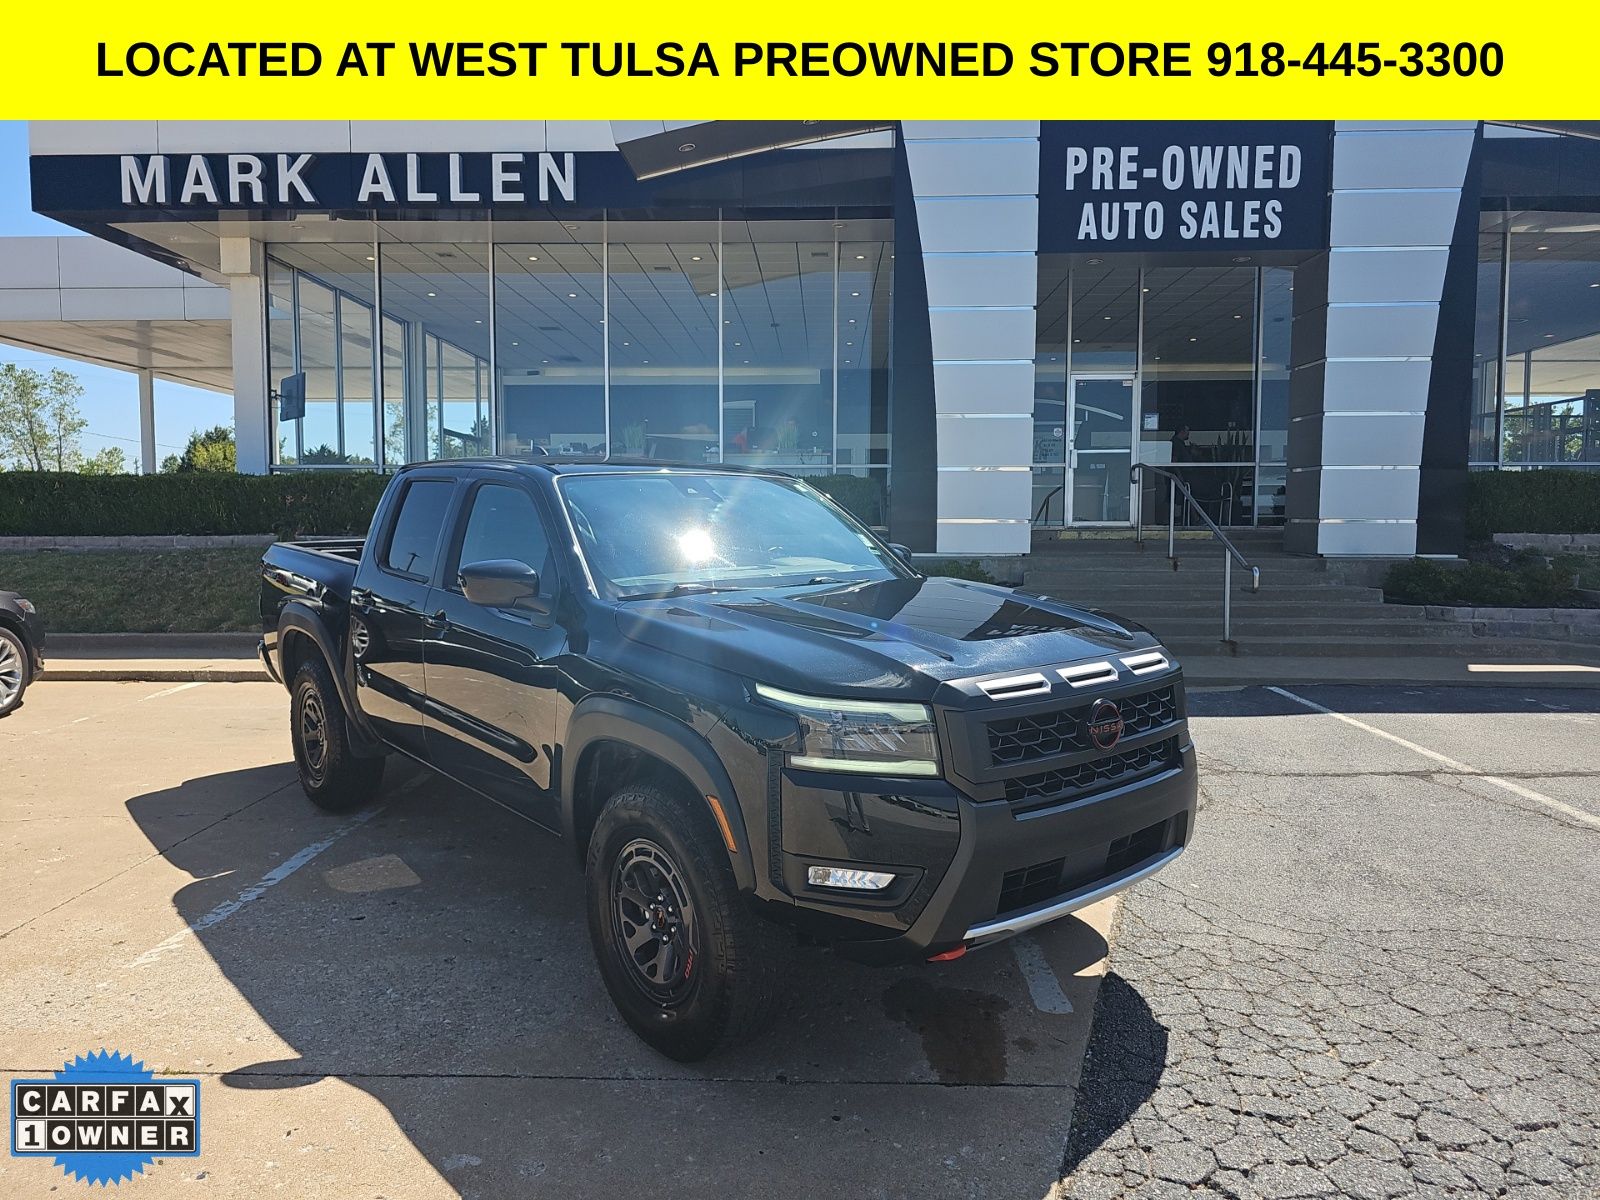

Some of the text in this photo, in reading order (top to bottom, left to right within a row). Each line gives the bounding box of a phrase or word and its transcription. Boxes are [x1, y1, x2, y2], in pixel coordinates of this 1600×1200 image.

[120, 152, 576, 205] MARK ALLEN
[1065, 145, 1302, 191] PRE-OWNED
[1077, 199, 1283, 240] AUTO SALES
[1090, 721, 1124, 734] NISS
